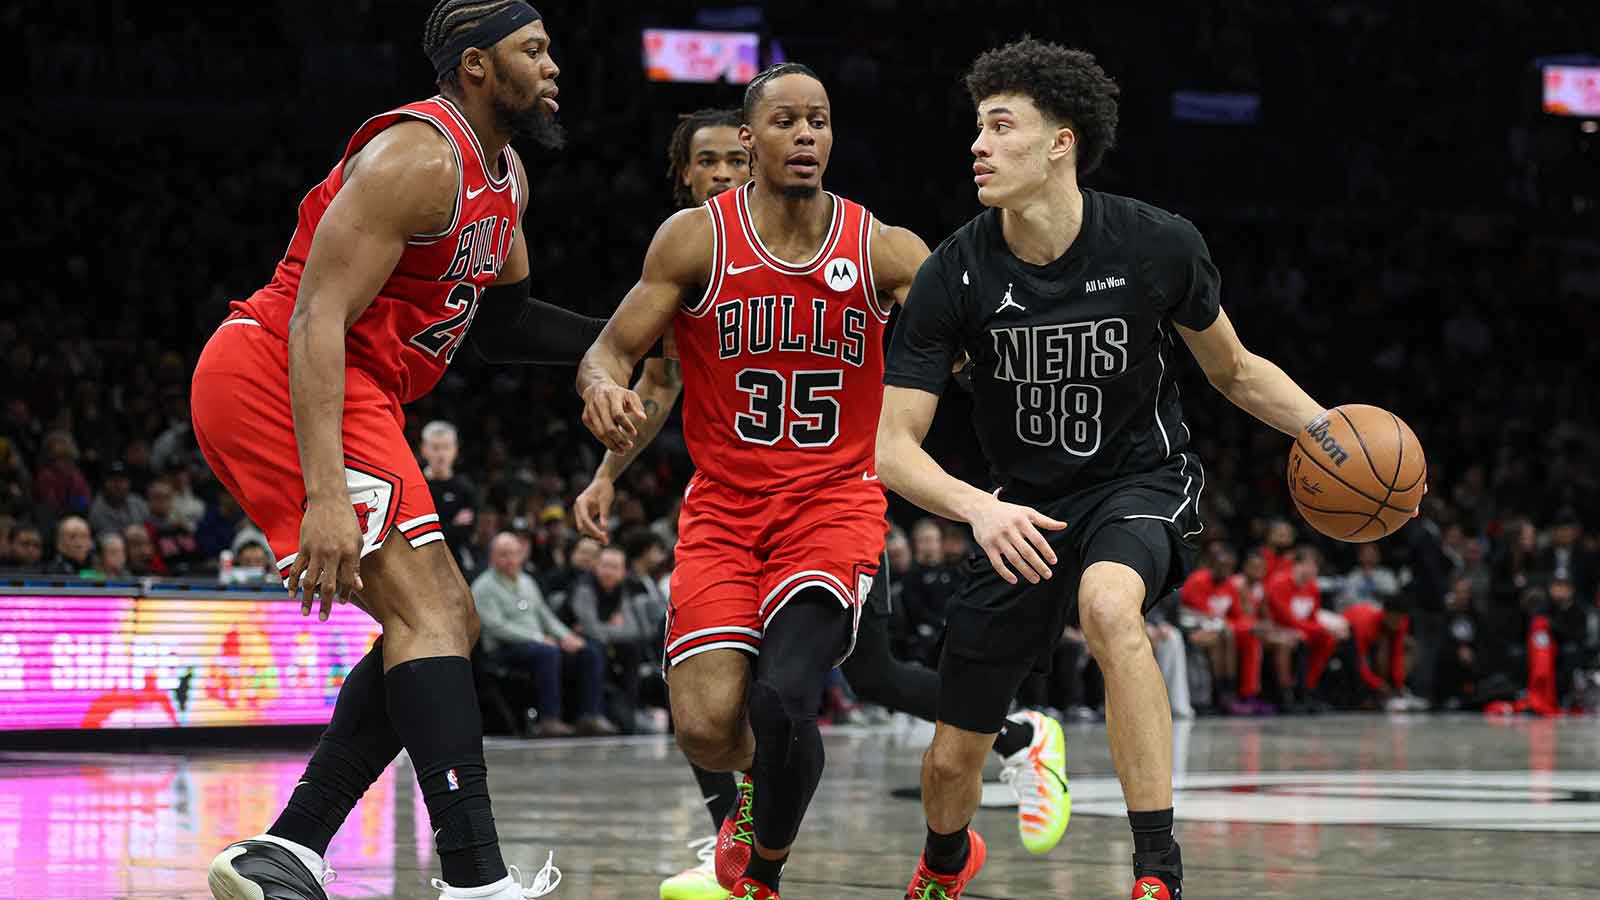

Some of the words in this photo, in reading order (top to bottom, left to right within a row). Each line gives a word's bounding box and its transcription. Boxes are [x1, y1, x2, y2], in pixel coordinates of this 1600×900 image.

[438, 216, 516, 280] BULL
[1085, 280, 1097, 293] All
[1097, 279, 1107, 291] In
[1105, 276, 1126, 289] Won
[409, 282, 485, 365] 2
[715, 295, 867, 368] BULLS
[990, 317, 1128, 384] NETS
[734, 367, 843, 448] 35
[1015, 383, 1103, 457] 88
[1305, 416, 1349, 466] ilson
